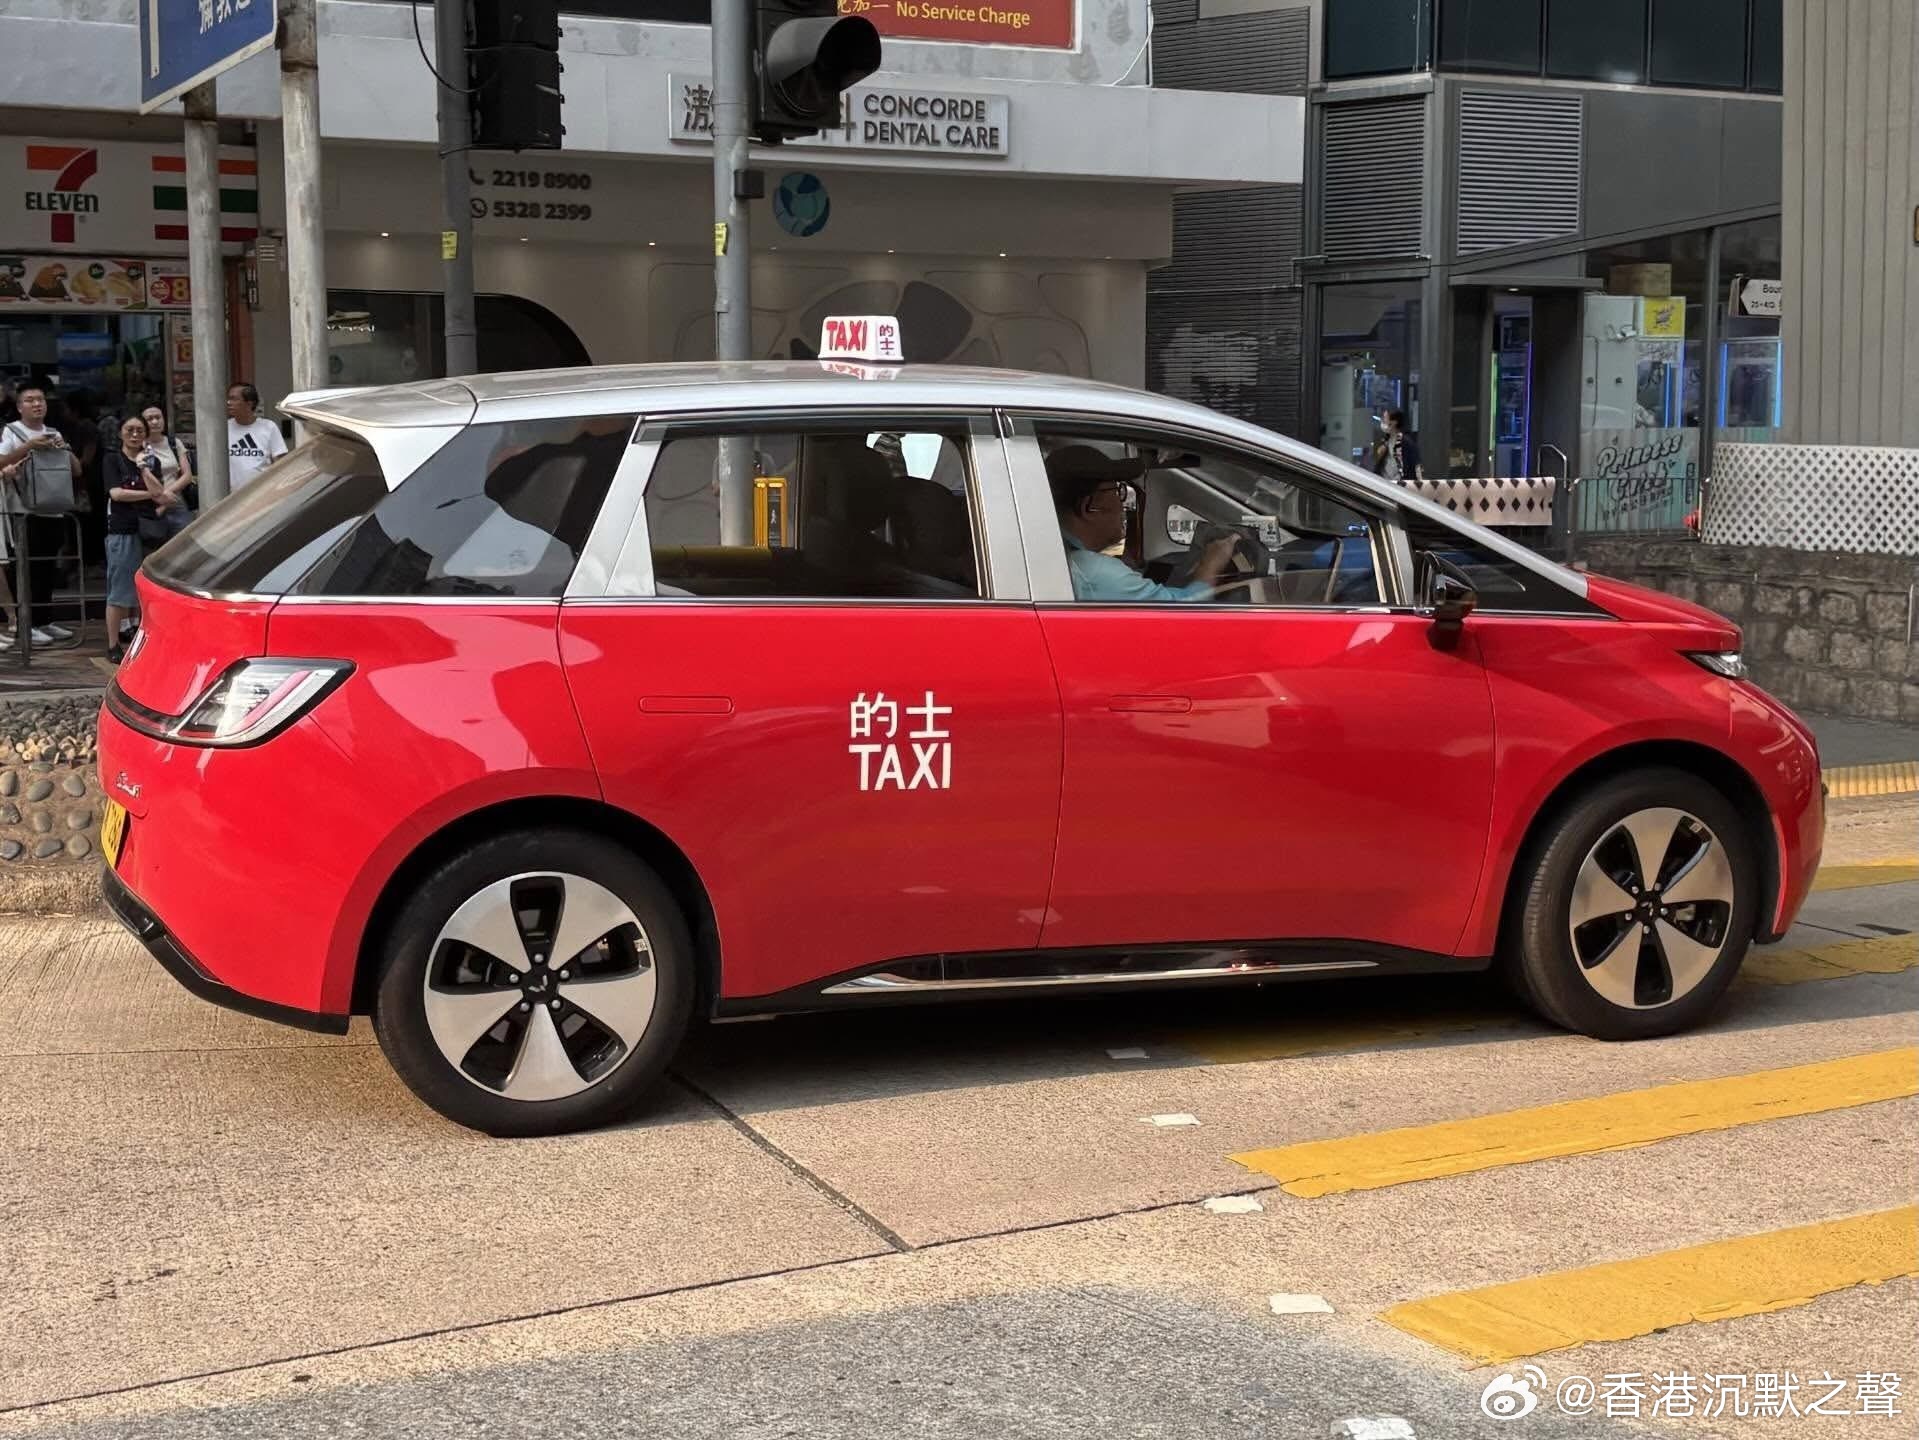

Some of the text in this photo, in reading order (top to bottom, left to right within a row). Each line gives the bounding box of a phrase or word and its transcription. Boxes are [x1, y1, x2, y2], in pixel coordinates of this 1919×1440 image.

[896, 1, 918, 18] No
[922, 3, 976, 22] Service
[979, 7, 1031, 29] Charge
[864, 93, 985, 120] CONCORDE
[864, 121, 999, 149] DENTAL CARE
[493, 170, 592, 190] 2219 8900
[493, 201, 592, 221] 5328 2399
[826, 320, 868, 351] TAXI
[879, 324, 895, 350] 的士
[850, 690, 953, 738] 的士
[849, 743, 952, 791] TAXI
